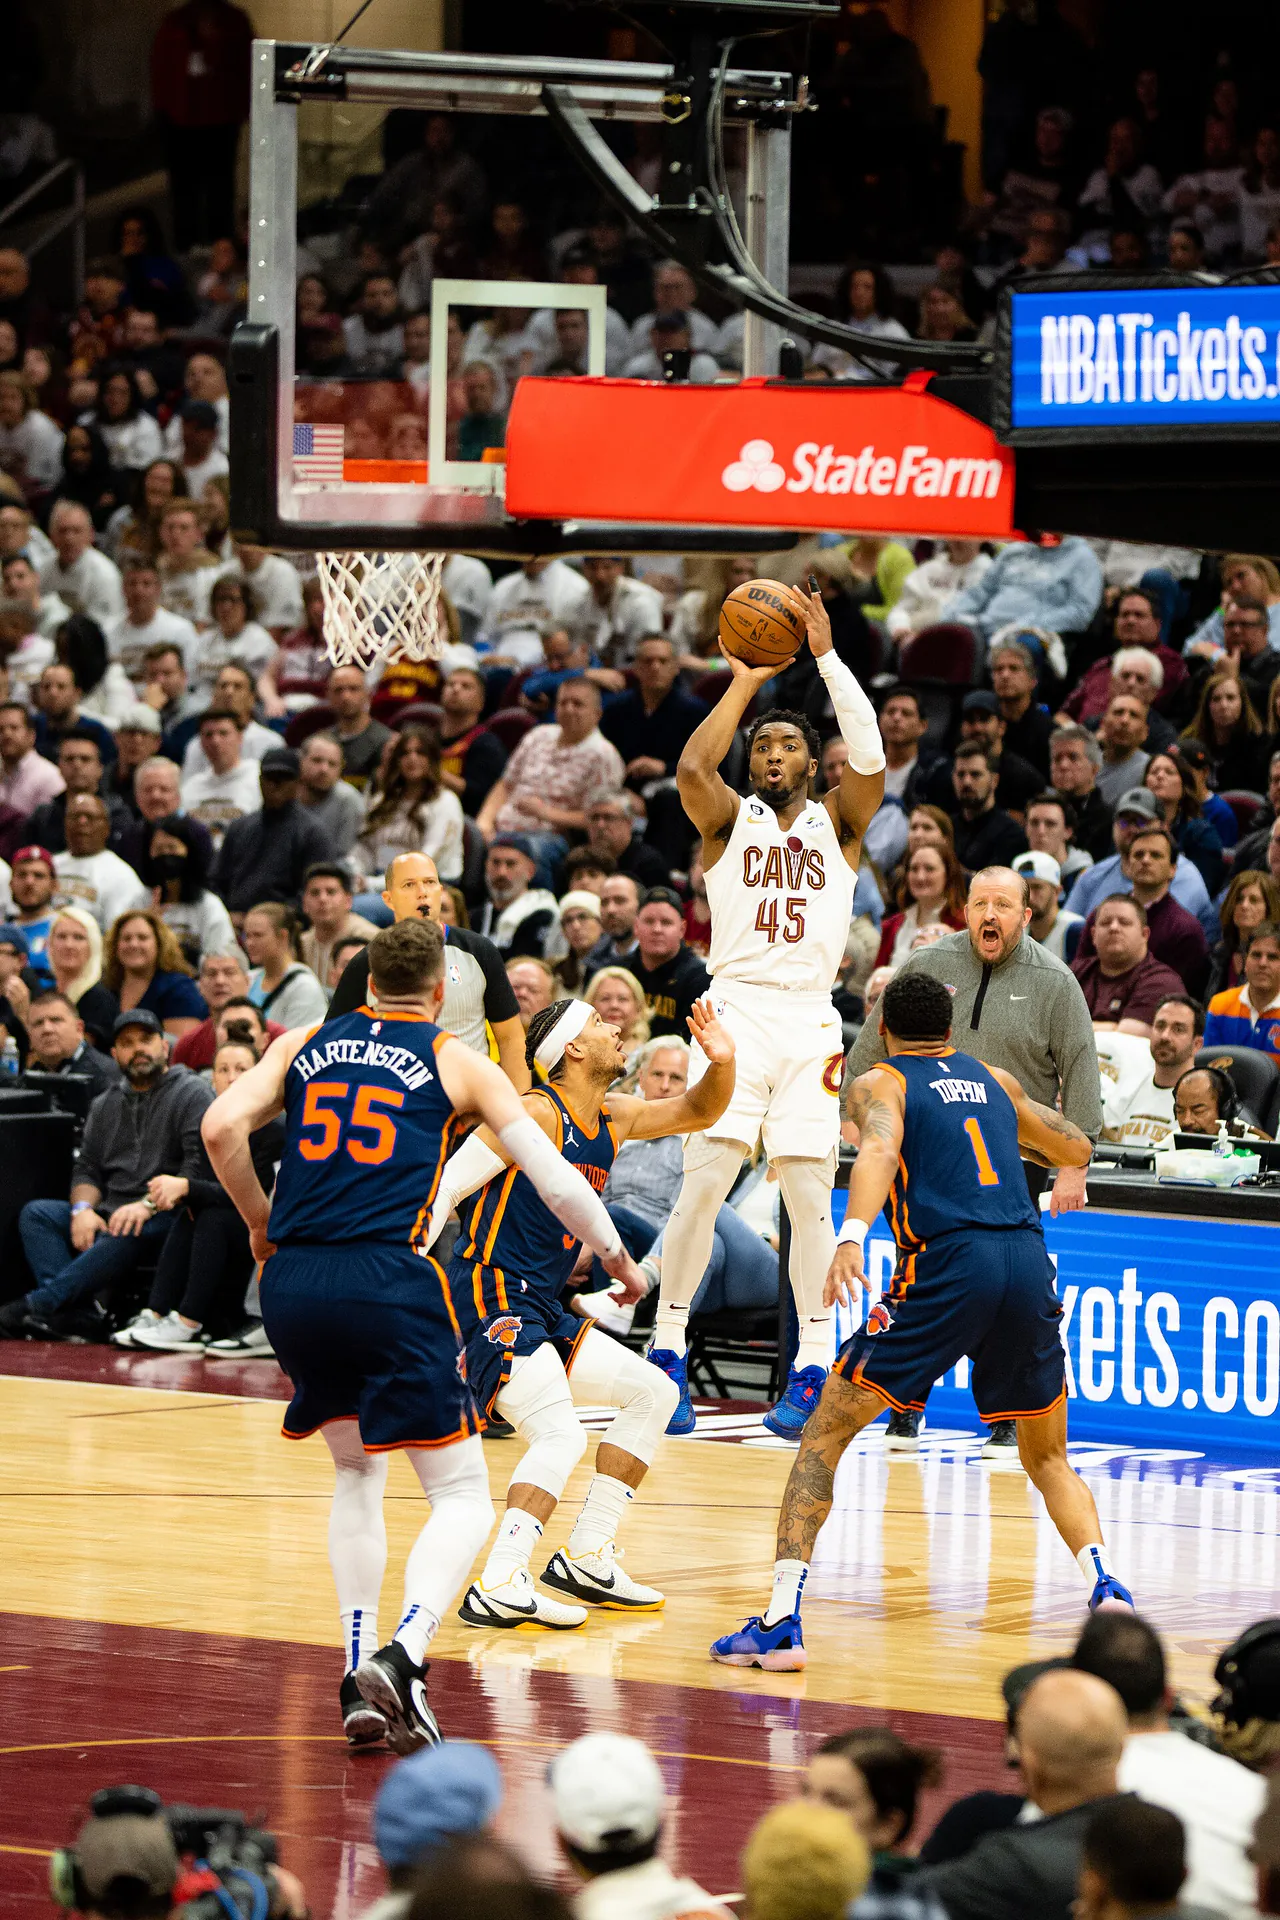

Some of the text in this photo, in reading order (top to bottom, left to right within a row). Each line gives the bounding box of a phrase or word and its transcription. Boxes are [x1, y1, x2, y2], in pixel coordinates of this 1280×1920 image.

[1040, 311, 1280, 405] NBATickets.
[747, 587, 798, 628] Wilson
[742, 845, 826, 891] CAVS
[754, 896, 807, 944] 45
[293, 1039, 435, 1091] HARTENSTEIN
[928, 1078, 988, 1104] TOPPIN
[298, 1081, 405, 1166] 55
[963, 1116, 1000, 1187] 1
